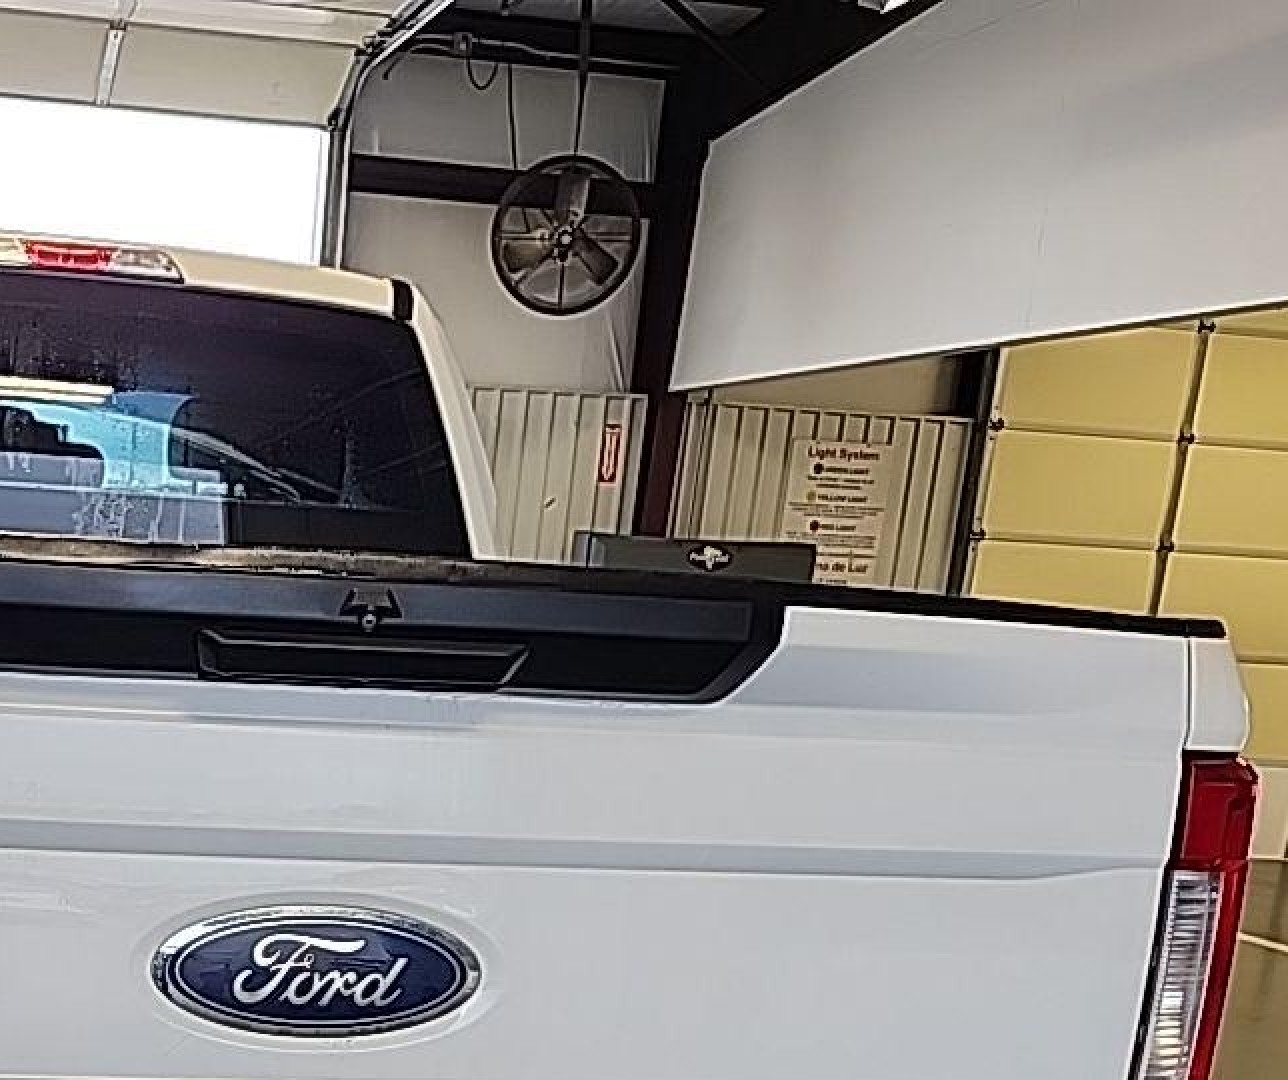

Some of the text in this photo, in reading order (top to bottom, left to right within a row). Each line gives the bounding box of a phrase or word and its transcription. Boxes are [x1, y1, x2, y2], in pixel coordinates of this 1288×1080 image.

[807, 446, 880, 462] Light System
[233, 933, 409, 1007] Ford
